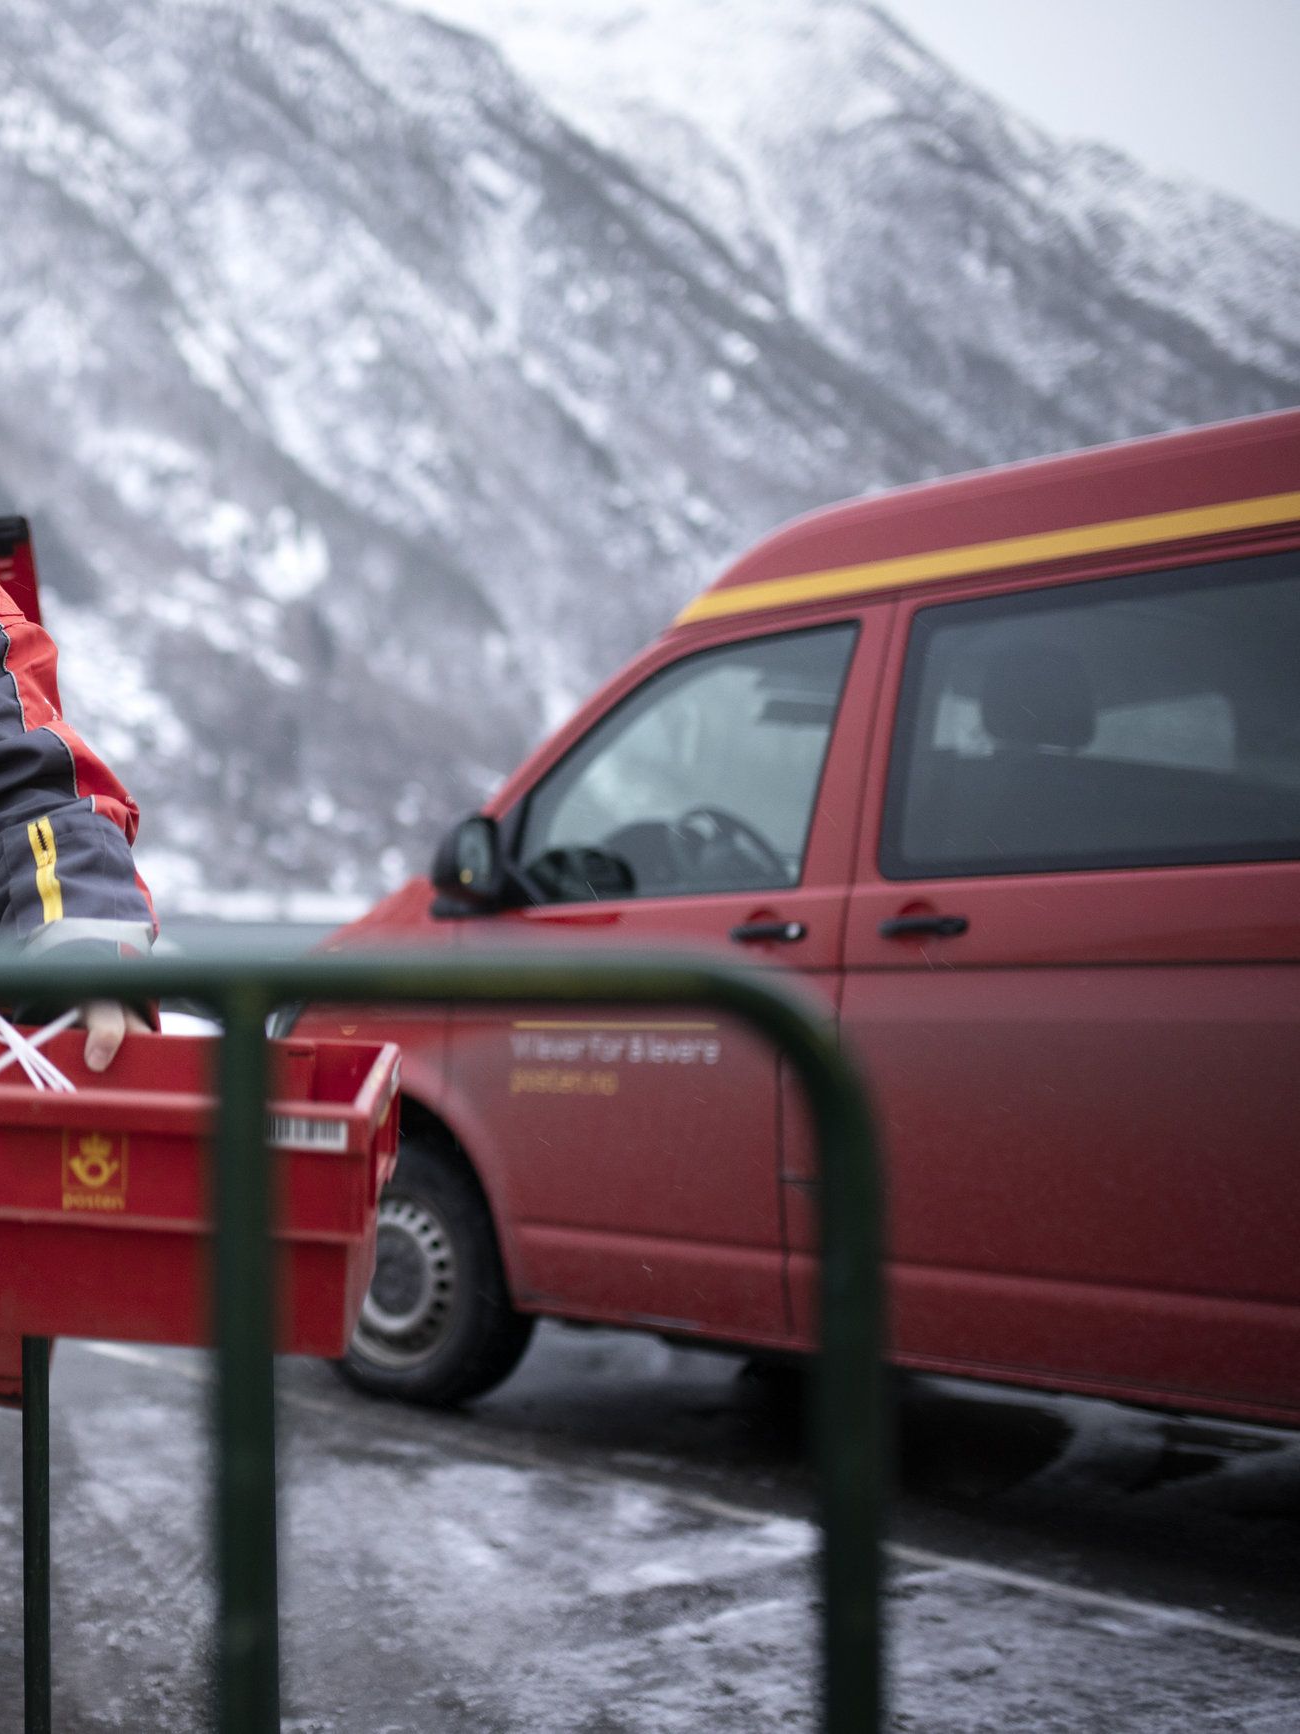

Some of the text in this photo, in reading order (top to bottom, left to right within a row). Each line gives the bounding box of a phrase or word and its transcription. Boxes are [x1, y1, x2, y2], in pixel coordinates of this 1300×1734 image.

[646, 1032, 722, 1065] levere
[509, 1068, 619, 1096] posten.no
[62, 1192, 125, 1211] posten
